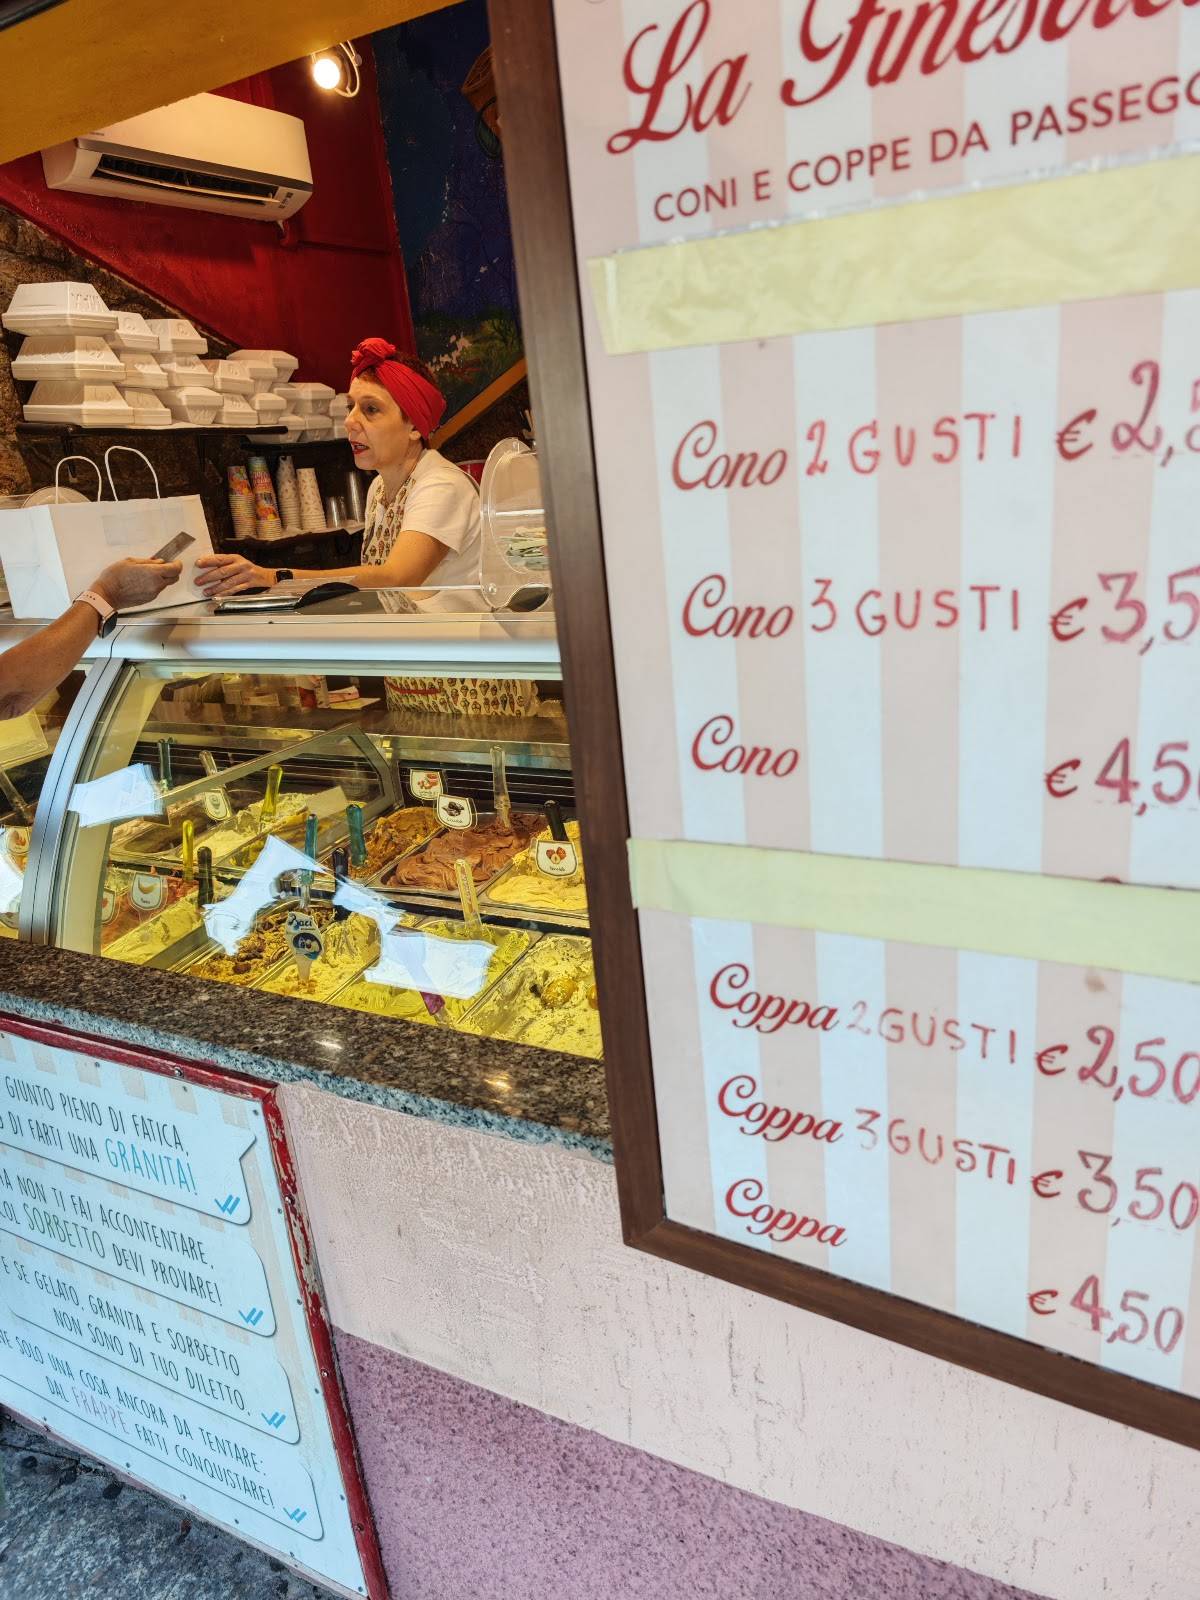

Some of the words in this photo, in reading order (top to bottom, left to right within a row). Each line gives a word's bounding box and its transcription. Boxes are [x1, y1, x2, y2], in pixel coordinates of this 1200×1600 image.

[606, 0, 752, 155] La
[653, 177, 738, 223] CONI
[752, 170, 772, 202] E
[787, 137, 912, 192] COPPE
[930, 121, 989, 162] DA
[671, 420, 789, 491] Cono
[804, 420, 828, 476] 2
[848, 412, 1022, 475] GUSTI
[681, 574, 795, 639] Cono
[810, 578, 838, 632] 3
[855, 585, 1020, 636] GUSTI
[690, 715, 799, 778] Cono
[709, 962, 839, 1034] Coppa
[847, 1001, 872, 1034] 2
[878, 1006, 1017, 1065] GUSTI
[1077, 1025, 1200, 1104] 2,50
[5, 1075, 55, 1111] GIUNTO
[59, 1092, 103, 1127] PIENO
[107, 1106, 126, 1135] DI
[8, 1110, 24, 1136] DI
[27, 1118, 63, 1151] FARTI
[67, 1131, 100, 1163] UNA
[104, 1137, 198, 1196] GRANITA!
[717, 1074, 844, 1144] Coppa
[854, 1107, 881, 1150] 3
[887, 1117, 1017, 1186] GUSTI
[1076, 1149, 1200, 1231] 3,50
[16, 1174, 47, 1204] NON
[51, 1187, 66, 1213] TI
[70, 1194, 93, 1223] FAI
[22, 1202, 105, 1258] SORBETTO
[112, 1243, 146, 1276] DEVI
[151, 1259, 222, 1307] PROVARE!
[725, 1178, 847, 1248] Coppa
[1069, 1273, 1186, 1355] 4,50
[13, 1260, 30, 1285] SE
[88, 1294, 146, 1337] GRANITA
[151, 1321, 162, 1344] E
[167, 1328, 240, 1377] SORBETTO
[52, 1307, 83, 1337] NON
[87, 1322, 124, 1356] SONO
[129, 1341, 145, 1367] DI
[150, 1351, 179, 1382] TUO
[15, 1335, 44, 1365] SOLO
[47, 1352, 75, 1381] UNA
[79, 1369, 111, 1399] COSA
[117, 1386, 169, 1429] ANCORA
[173, 1413, 194, 1440] DA
[198, 1426, 266, 1477] TENTARE:
[45, 1375, 70, 1403] DAL
[135, 1423, 169, 1455] FATTI
[174, 1444, 276, 1510] CONQUISTARE!
